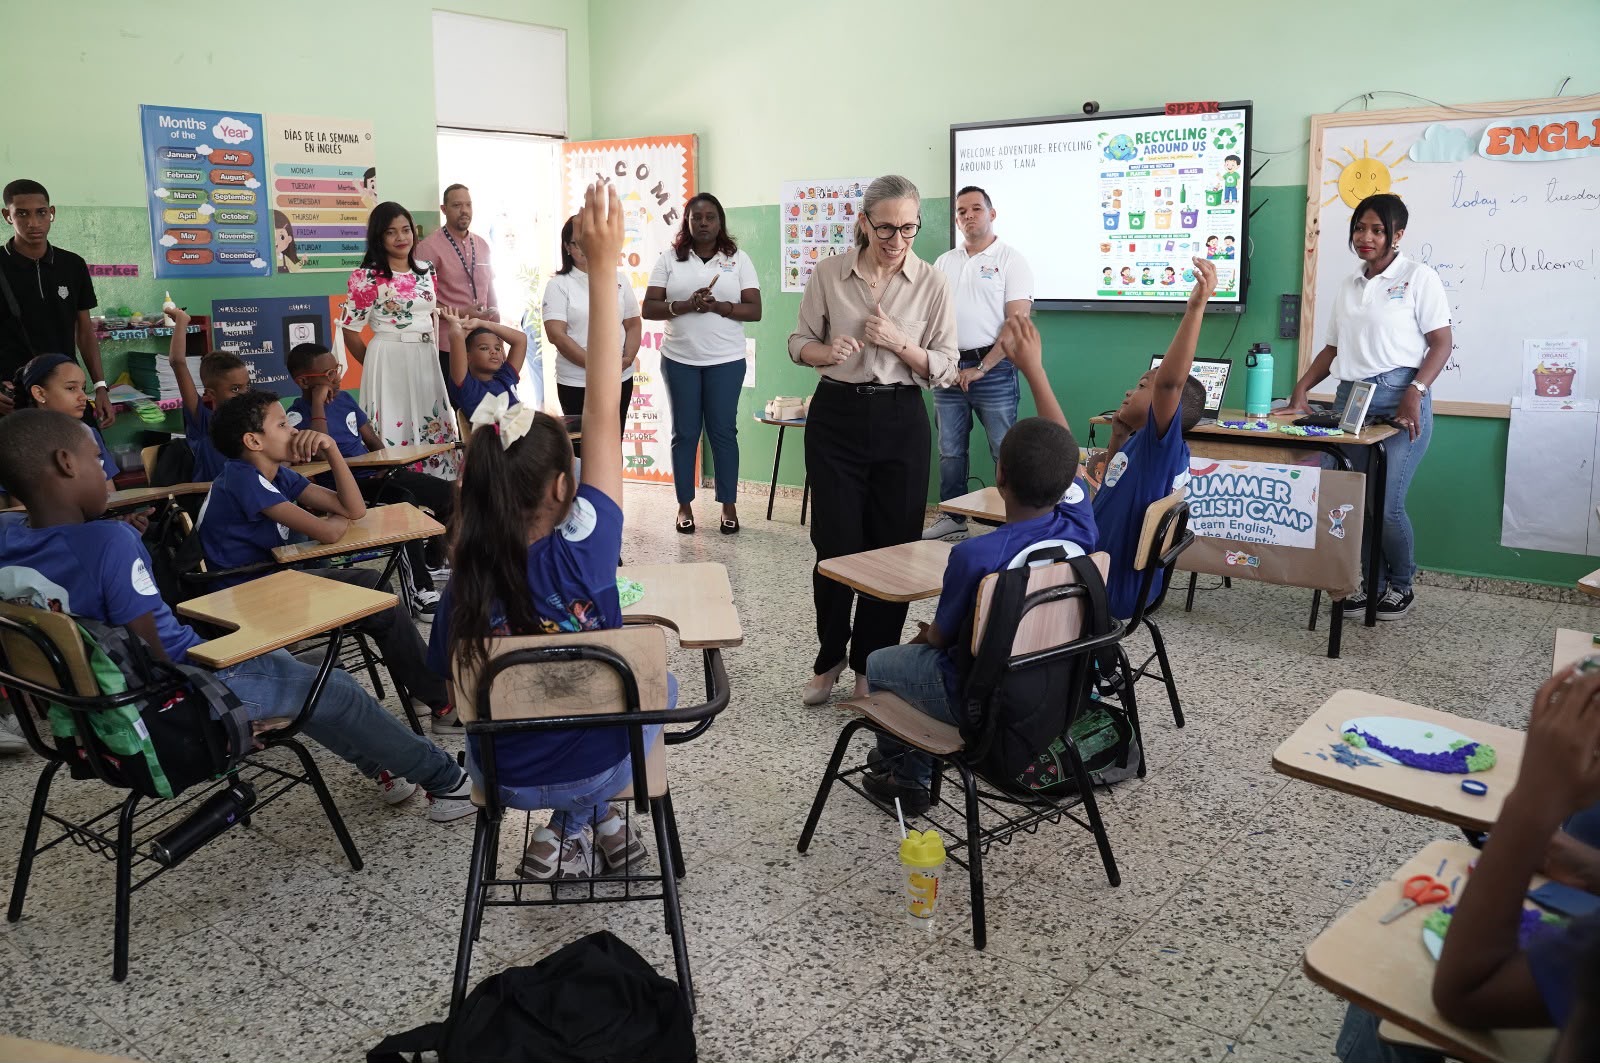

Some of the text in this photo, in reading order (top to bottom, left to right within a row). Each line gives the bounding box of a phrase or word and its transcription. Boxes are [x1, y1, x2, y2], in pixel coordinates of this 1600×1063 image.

[1166, 102, 1219, 116] SPEAK
[159, 116, 206, 130] Months
[170, 130, 196, 140] of the
[220, 125, 248, 138] Year
[1136, 127, 1207, 145] RECYCLING
[305, 131, 314, 141] DE
[317, 132, 326, 142] LA
[330, 133, 359, 144] SEMANA
[305, 143, 314, 153] EN
[960, 140, 1092, 158] WELCOME ADVENTURE: RECYCLING
[1143, 141, 1206, 155] AROUND US
[166, 151, 197, 160] January
[224, 154, 238, 162] July
[960, 158, 1036, 172] AROUND US T.ANA
[166, 172, 199, 180] February
[214, 194, 253, 202] September
[1510, 193, 1528, 204] is
[179, 212, 196, 220] April
[154, 325, 200, 336] Craon
[634, 375, 649, 383] ARN
[643, 412, 657, 420] FUN
[1188, 498, 1313, 532] GLISH CAMP
[1194, 520, 1276, 538] Learn English,
